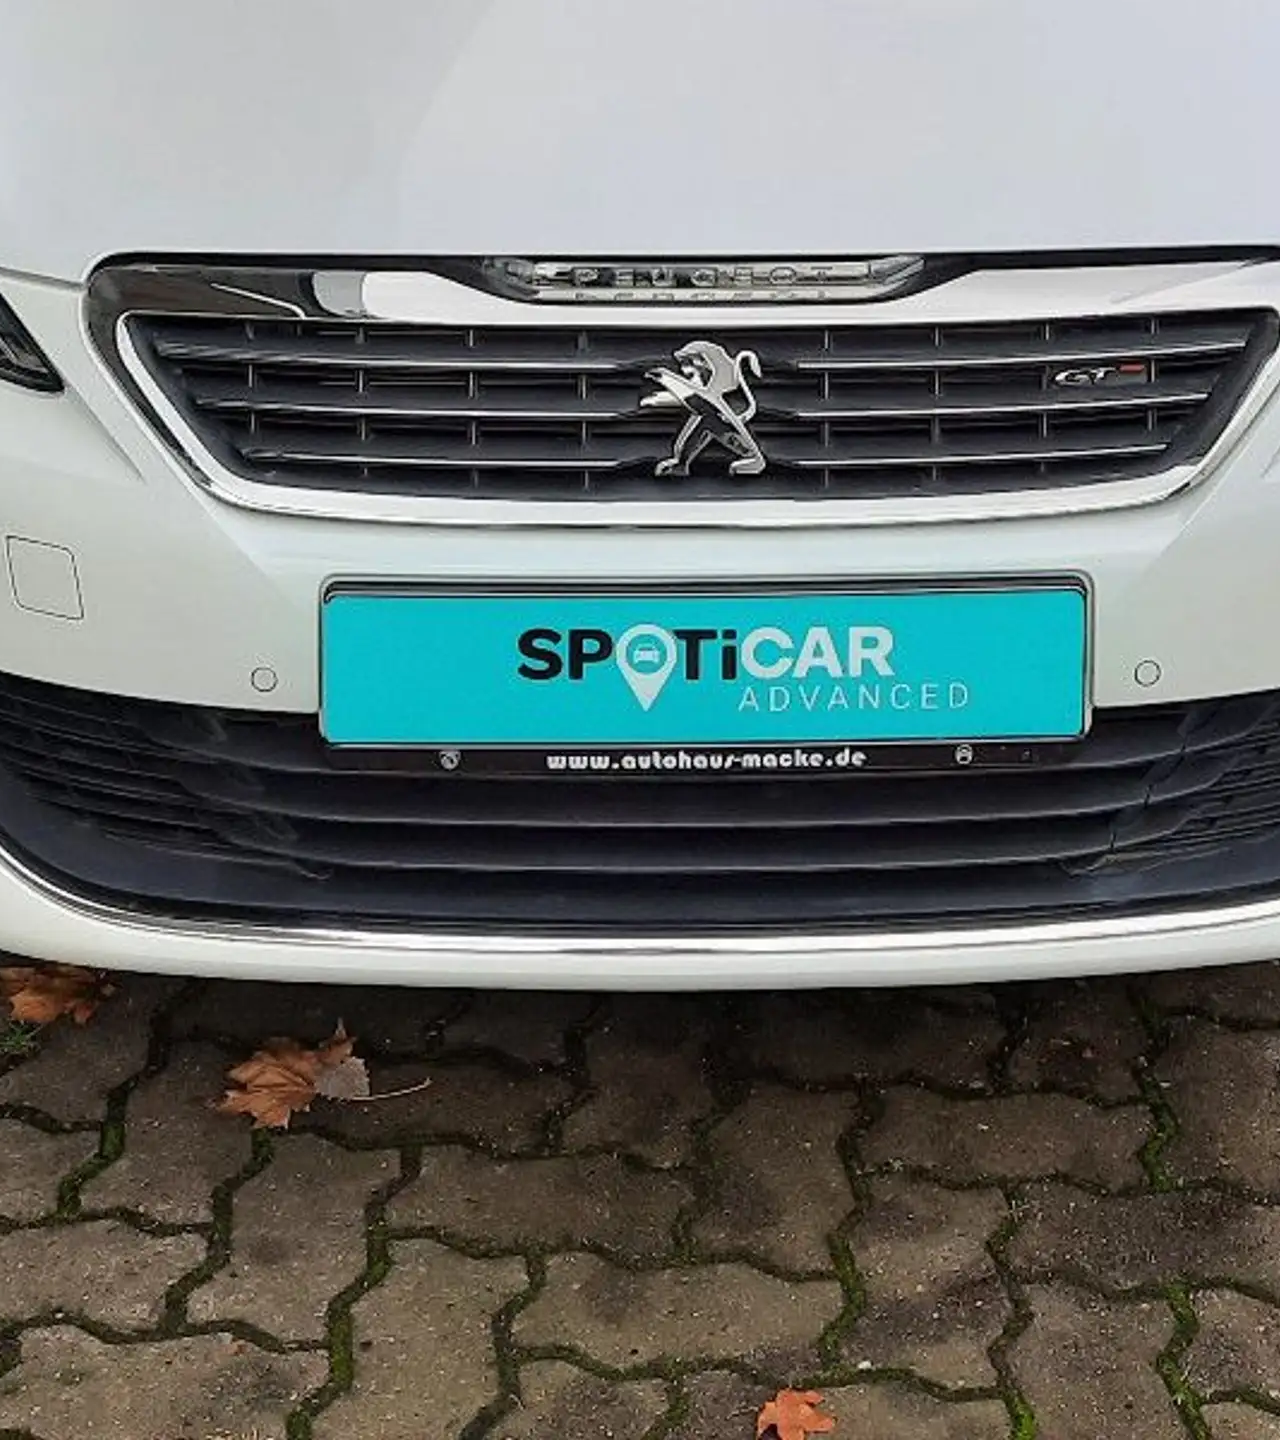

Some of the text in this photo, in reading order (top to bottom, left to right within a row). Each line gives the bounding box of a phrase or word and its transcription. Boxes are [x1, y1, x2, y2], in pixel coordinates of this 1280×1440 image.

[570, 265, 836, 288] PEUGEOT
[737, 682, 970, 713] ADVANCED
[545, 744, 868, 771] www.autohaus-macke.de
